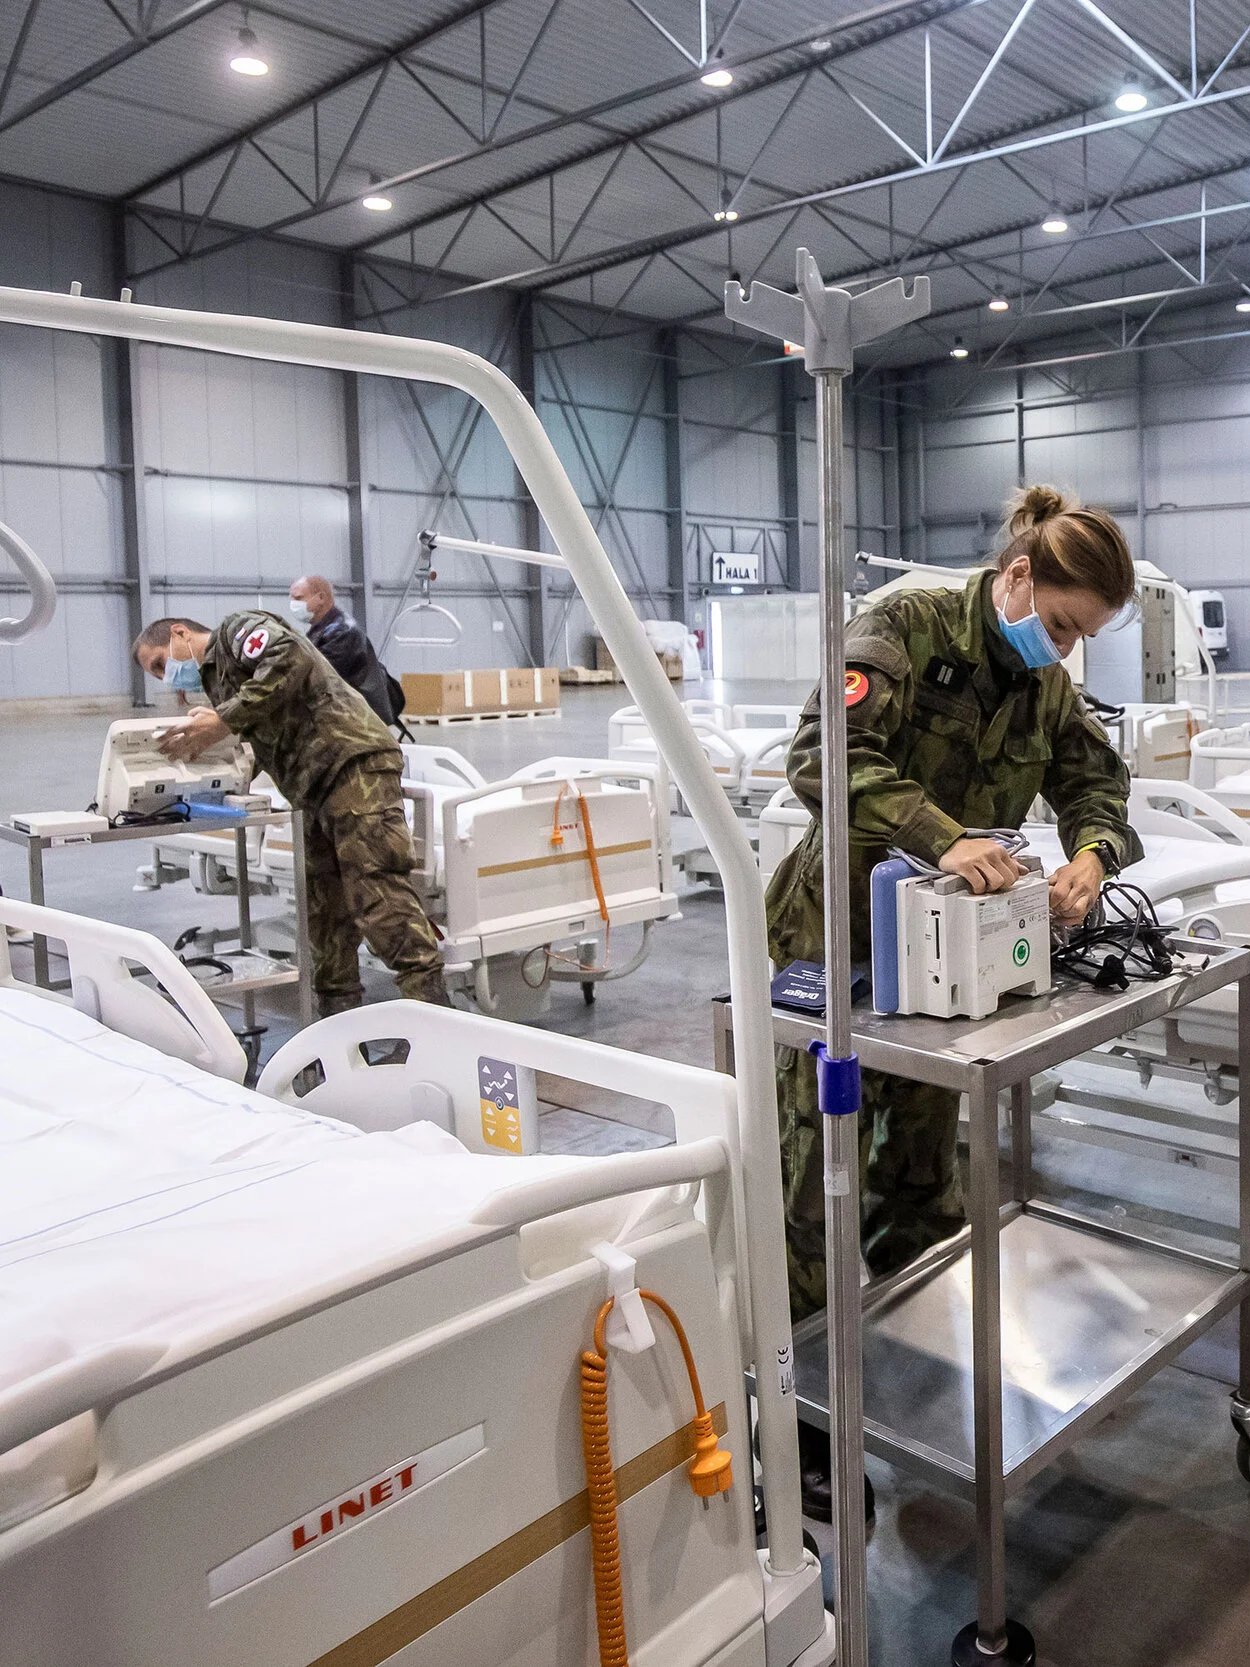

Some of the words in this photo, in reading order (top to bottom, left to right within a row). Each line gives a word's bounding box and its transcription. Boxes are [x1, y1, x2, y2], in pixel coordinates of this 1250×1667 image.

[725, 567, 750, 580] HALA
[753, 569, 758, 579] 1
[781, 988, 820, 1000] Dräger
[291, 1462, 418, 1551] LINET
